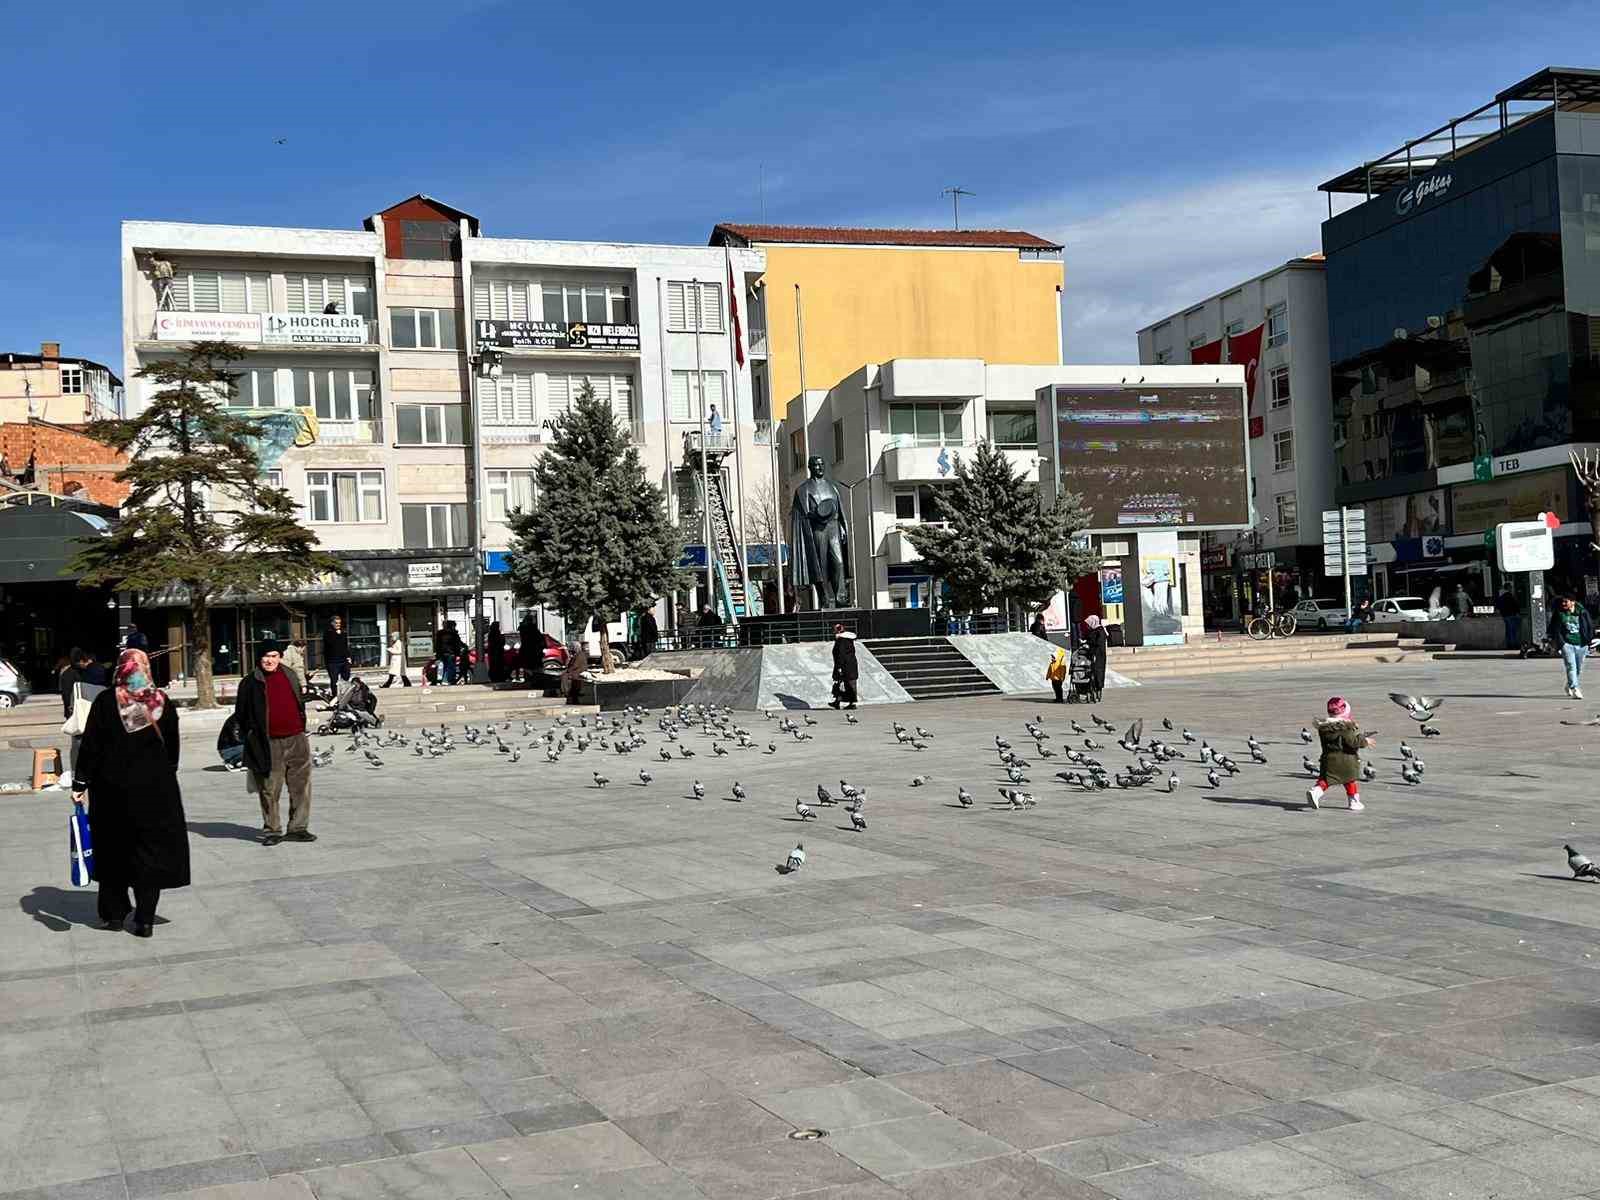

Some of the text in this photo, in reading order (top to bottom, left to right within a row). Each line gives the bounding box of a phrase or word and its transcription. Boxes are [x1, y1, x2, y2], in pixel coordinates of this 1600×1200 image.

[290, 317, 360, 328] HOCALAR
[509, 322, 558, 331] HOCALAR
[1498, 459, 1520, 473] TEB
